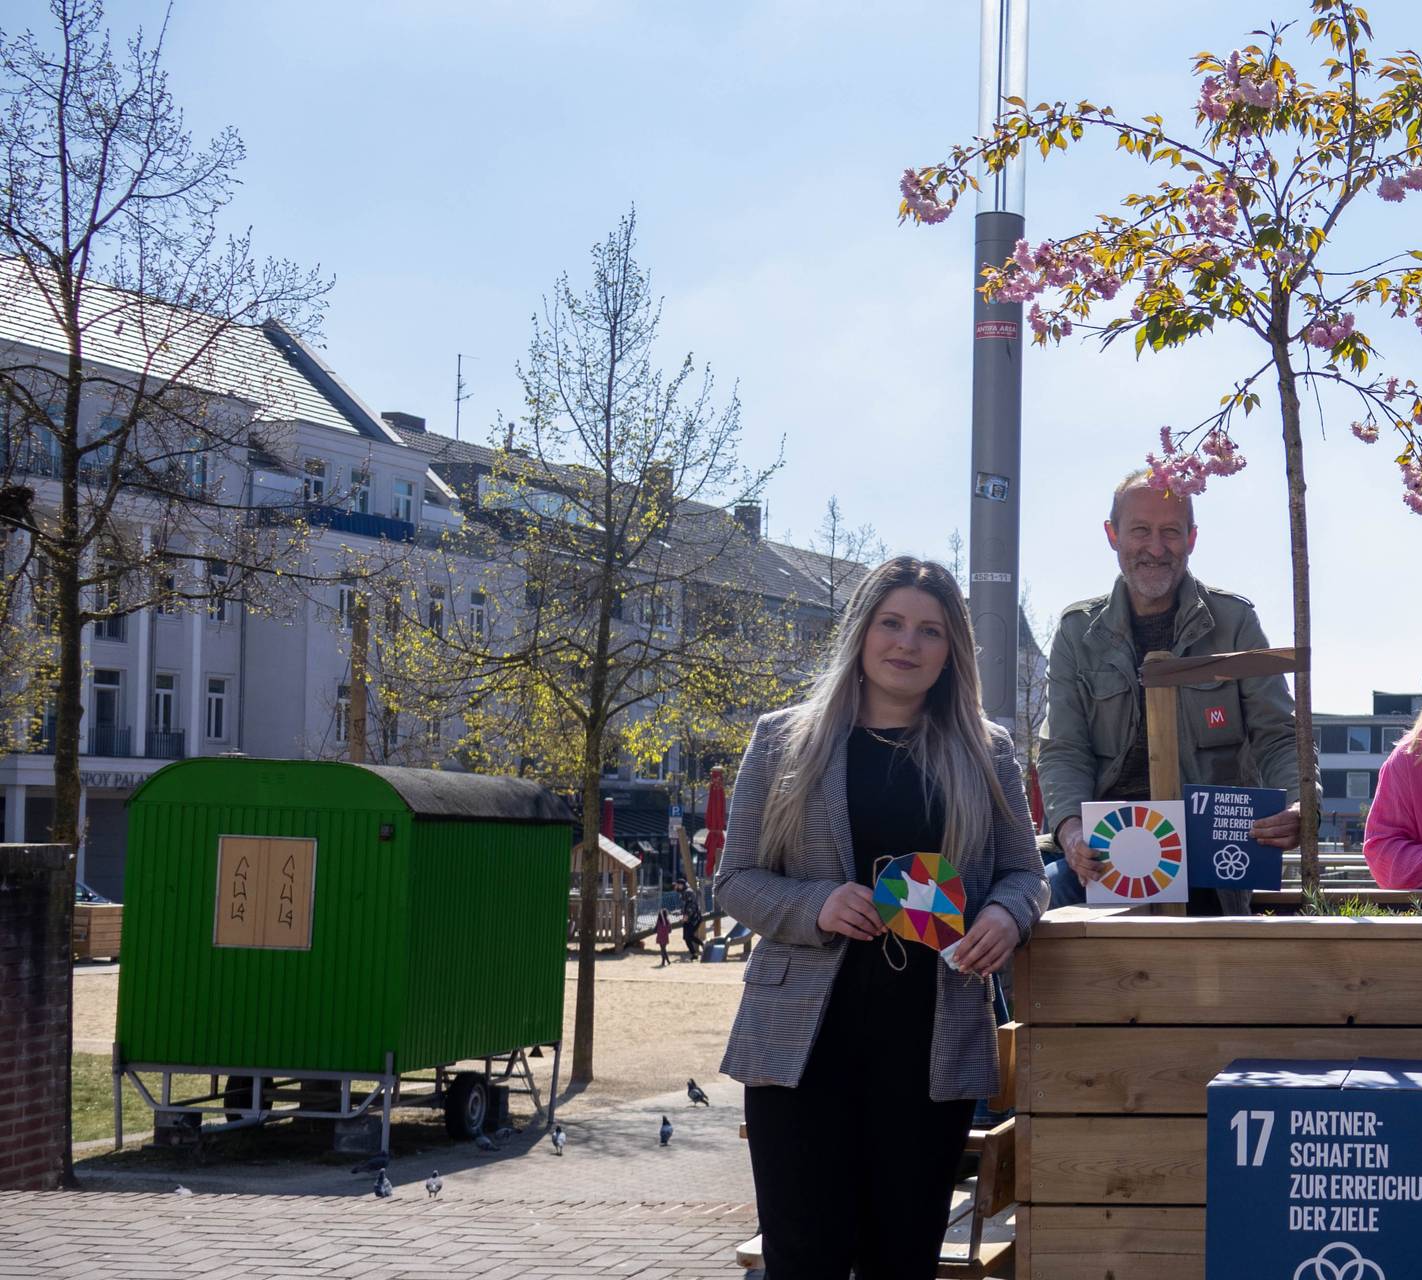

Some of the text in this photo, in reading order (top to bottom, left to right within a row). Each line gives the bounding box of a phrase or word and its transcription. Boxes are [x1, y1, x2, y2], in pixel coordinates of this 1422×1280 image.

[672, 806, 681, 816] P
[1191, 791, 1252, 815] 17 PARTNER-
[1213, 805, 1253, 817] SCHAFTEN
[1213, 817, 1228, 829] ZUR
[1212, 829, 1248, 842] DER ZIELE
[1230, 1110, 1384, 1167] 17 PARTNER-
[1290, 1143, 1389, 1168] SCHAFTEN
[1289, 1174, 1328, 1200] ZUR
[1289, 1205, 1380, 1232] DER ZIELE
